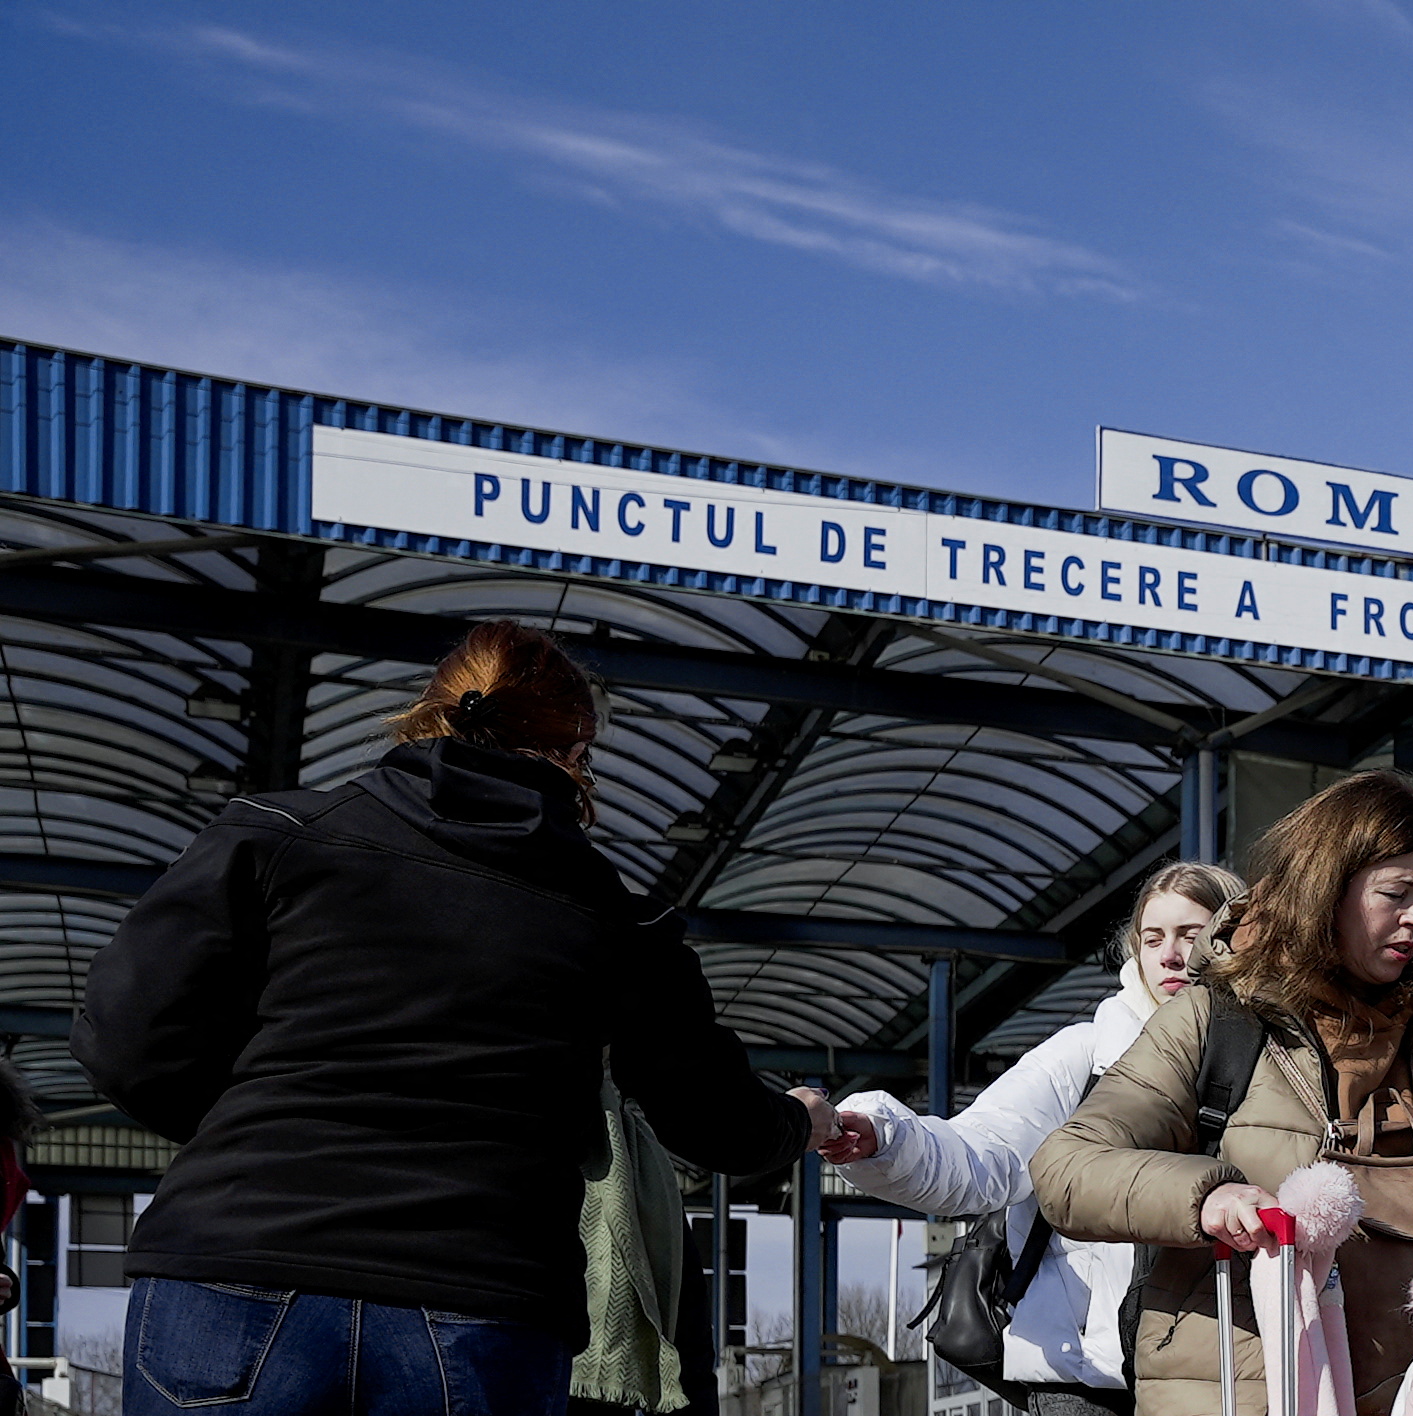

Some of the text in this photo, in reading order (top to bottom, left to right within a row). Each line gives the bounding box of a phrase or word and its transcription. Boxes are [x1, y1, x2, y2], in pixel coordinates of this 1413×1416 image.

[473, 472, 777, 556] PUNCTUL
[820, 520, 887, 570] DE
[941, 537, 1198, 613] TRECERE
[1234, 580, 1260, 621] A
